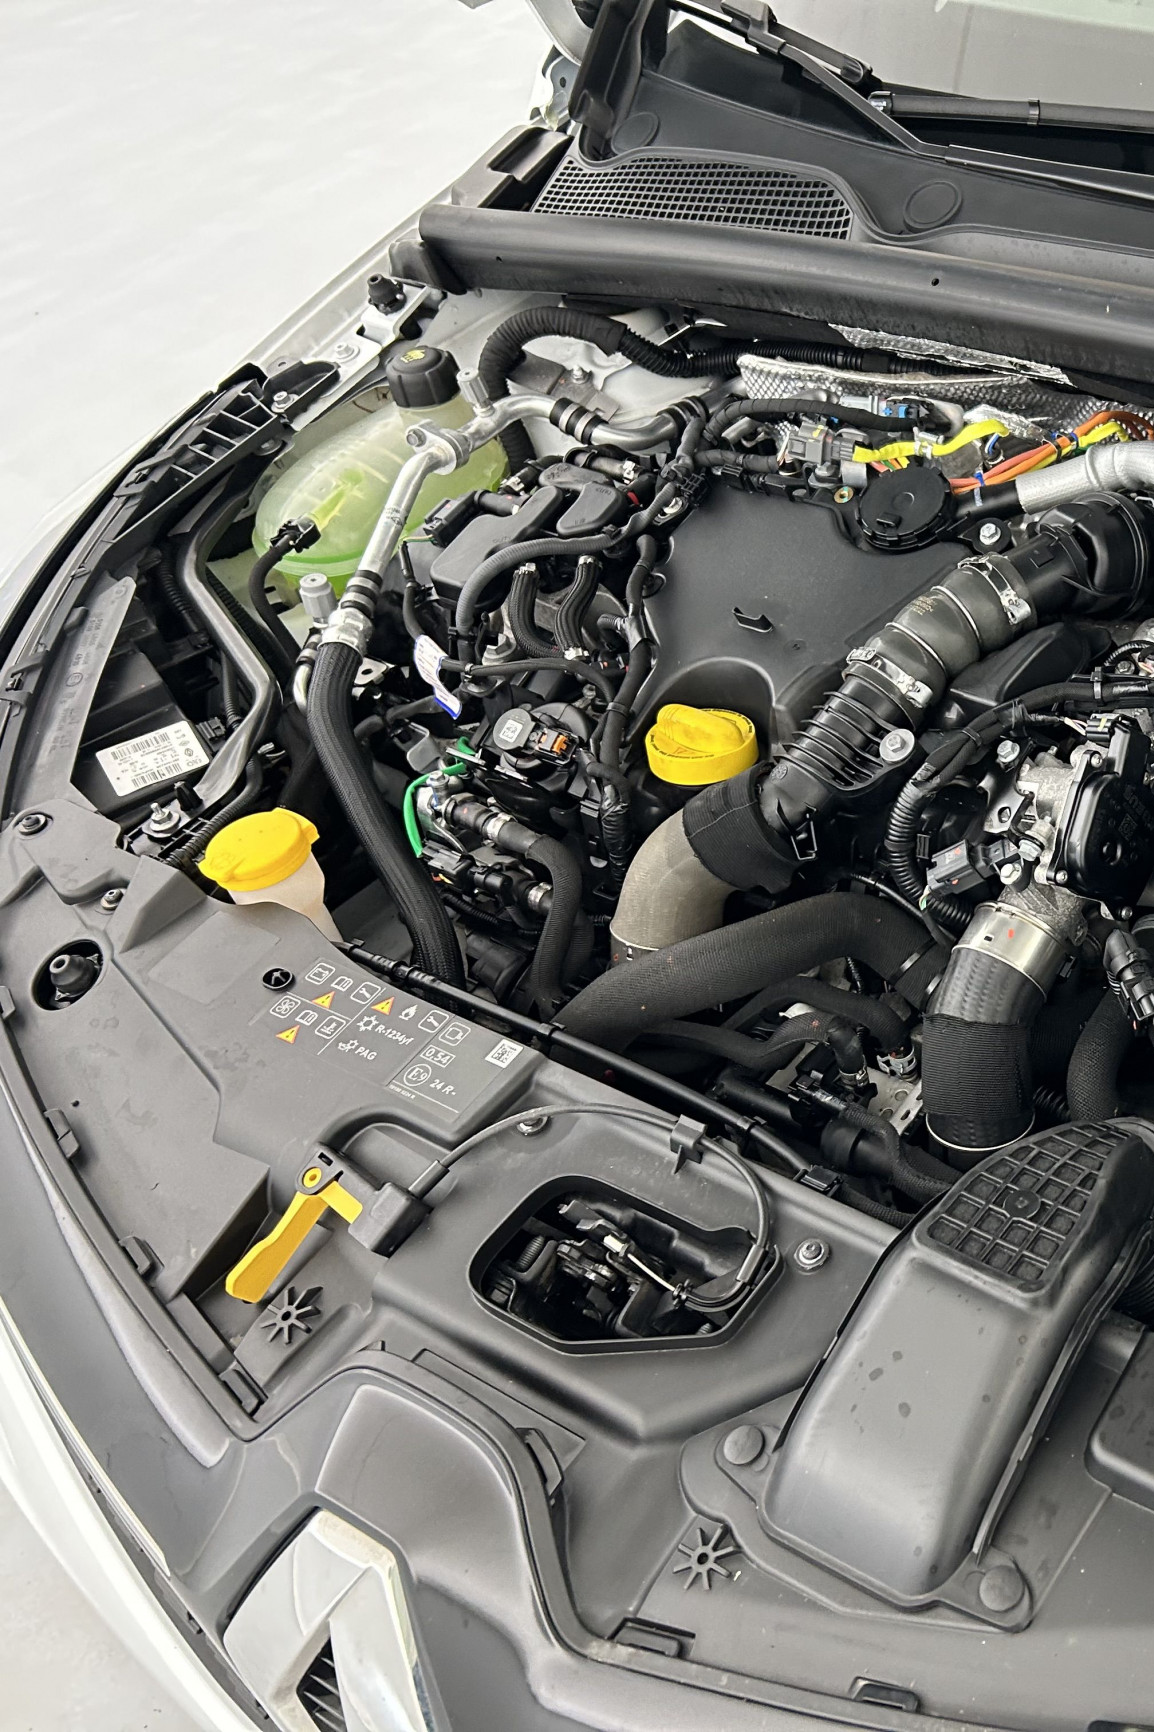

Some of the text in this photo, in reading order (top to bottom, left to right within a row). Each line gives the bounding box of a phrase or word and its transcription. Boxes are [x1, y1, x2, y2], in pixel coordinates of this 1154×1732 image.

[375, 1024, 413, 1045] R-1234yf
[355, 1047, 377, 1060] PAG
[429, 1079, 445, 1090] 24
